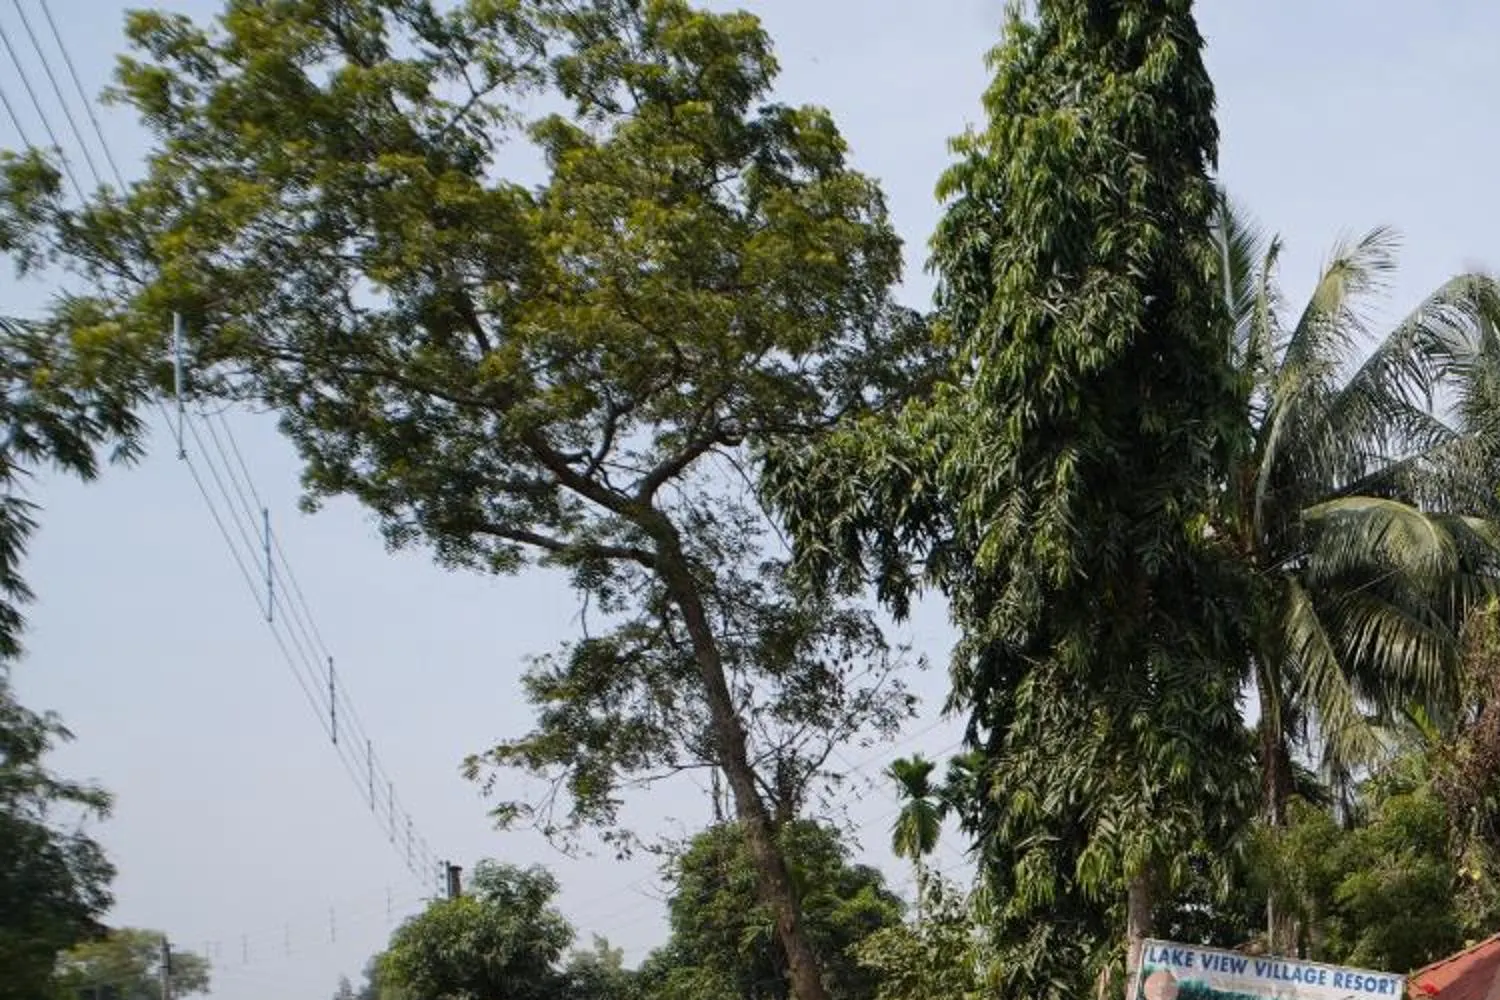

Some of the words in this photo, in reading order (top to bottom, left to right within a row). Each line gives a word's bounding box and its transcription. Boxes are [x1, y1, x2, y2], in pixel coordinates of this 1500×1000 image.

[1150, 947, 1193, 968] LAKE
[1201, 953, 1248, 975] VIEW
[1255, 958, 1327, 986] VILLAGE
[1333, 972, 1396, 995] RESORT
